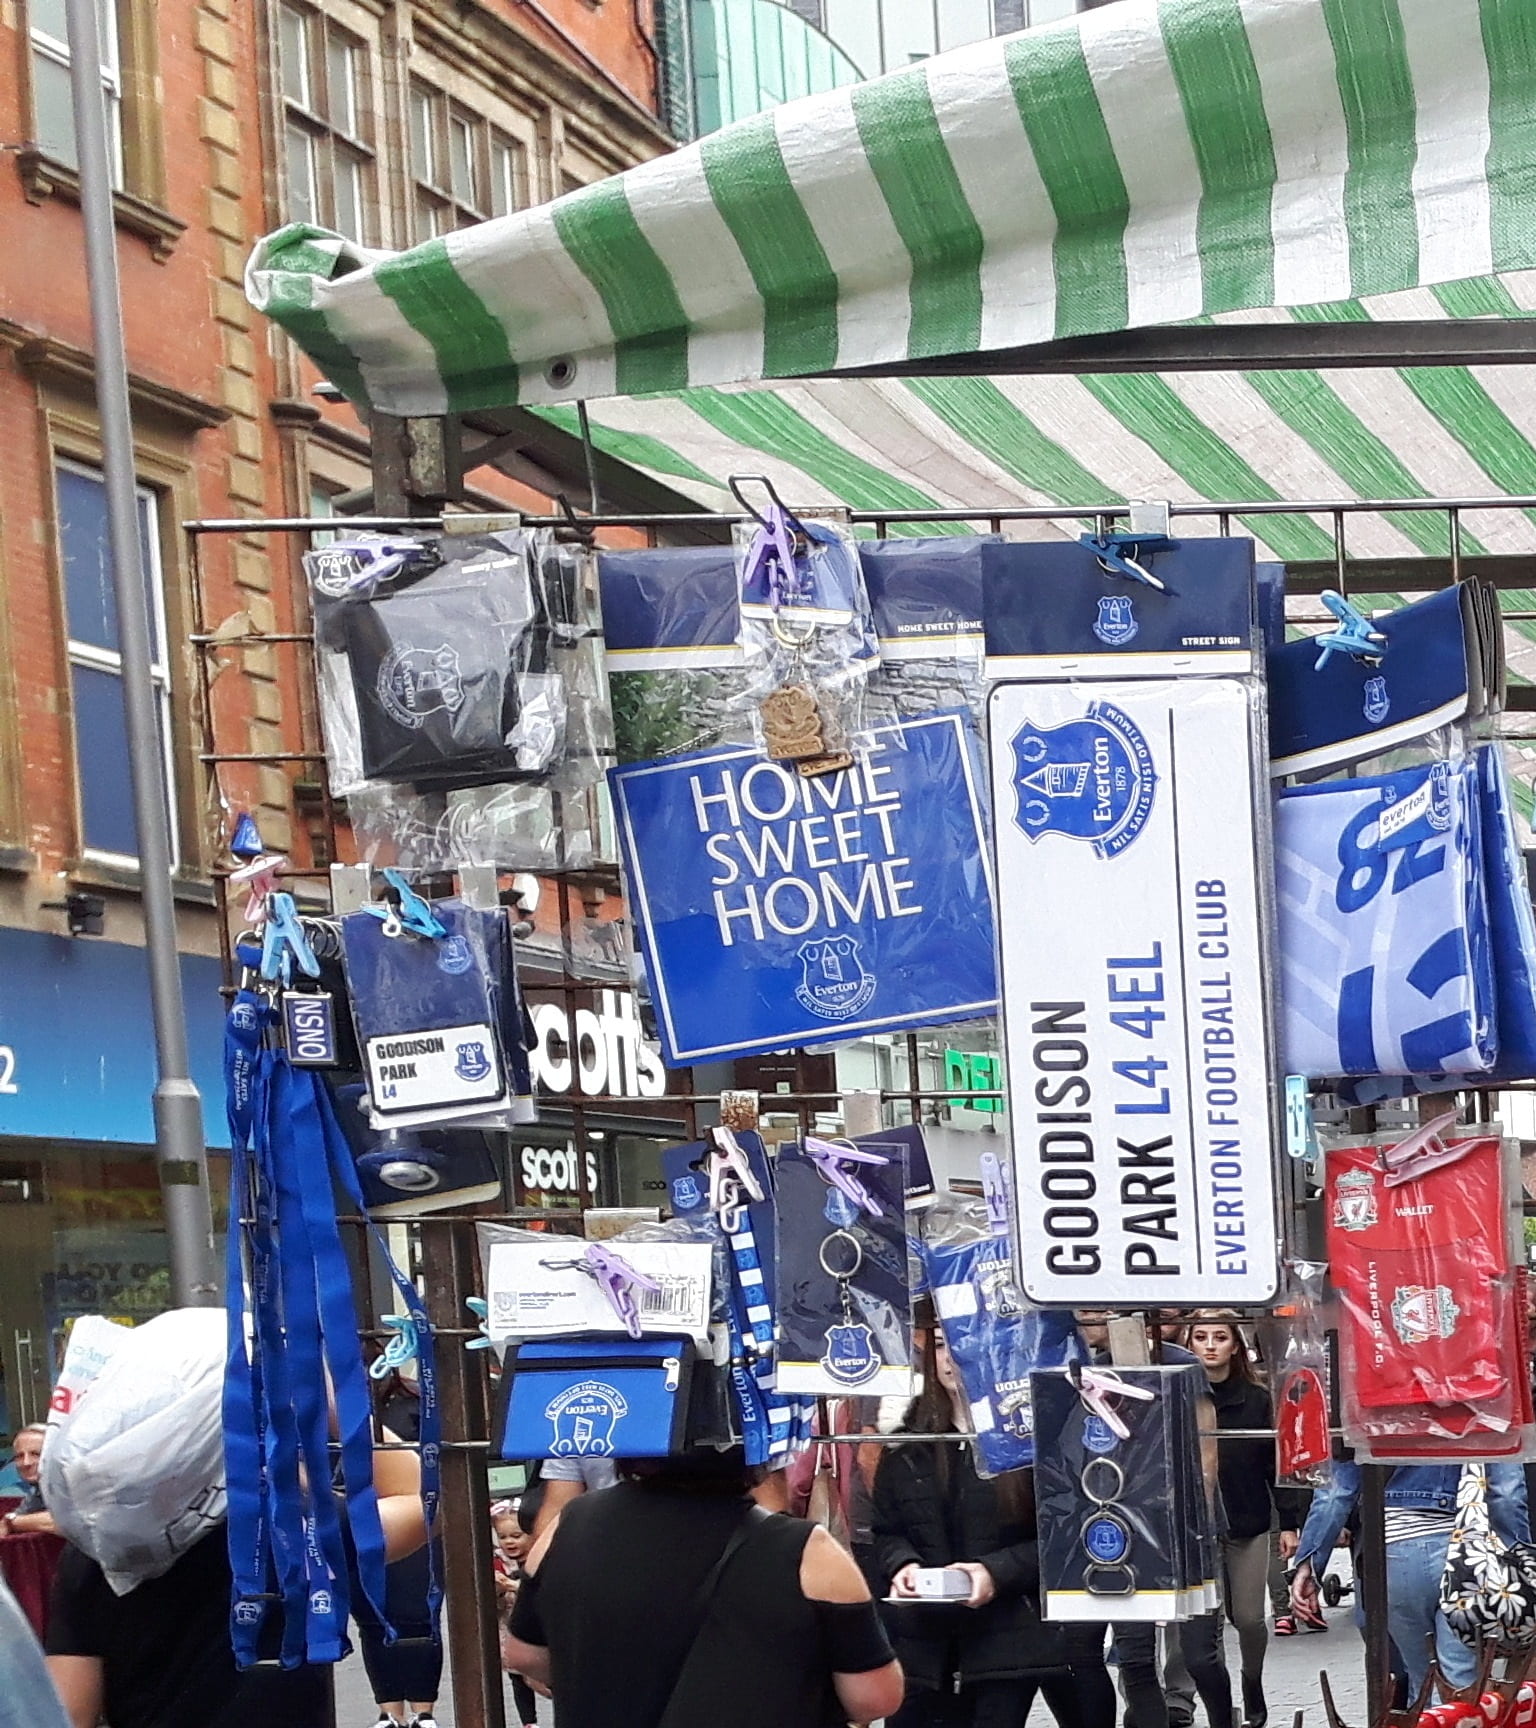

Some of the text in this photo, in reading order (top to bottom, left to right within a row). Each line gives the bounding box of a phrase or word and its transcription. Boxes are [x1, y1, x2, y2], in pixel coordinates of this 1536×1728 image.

[1182, 636, 1240, 645] STREET SIGN
[690, 735, 900, 831] HOME
[1093, 738, 1111, 822] Everton
[1106, 708, 1151, 850] NIL SATIS NISI OPTIMUM
[706, 804, 900, 886] SWEET
[712, 858, 922, 946] HOME
[375, 1039, 445, 1060] GOODISON
[381, 1064, 417, 1081] PARK
[1196, 880, 1247, 1276] EVERTON FOOTBALL CLUB
[383, 1084, 397, 1100] L4
[1107, 941, 1180, 1275] PARK L4 4EL
[521, 1140, 598, 1192] scots
[1031, 1001, 1101, 1275] GOODISON
[1396, 1205, 1434, 1217] WALLET
[835, 1358, 866, 1366] Everton
